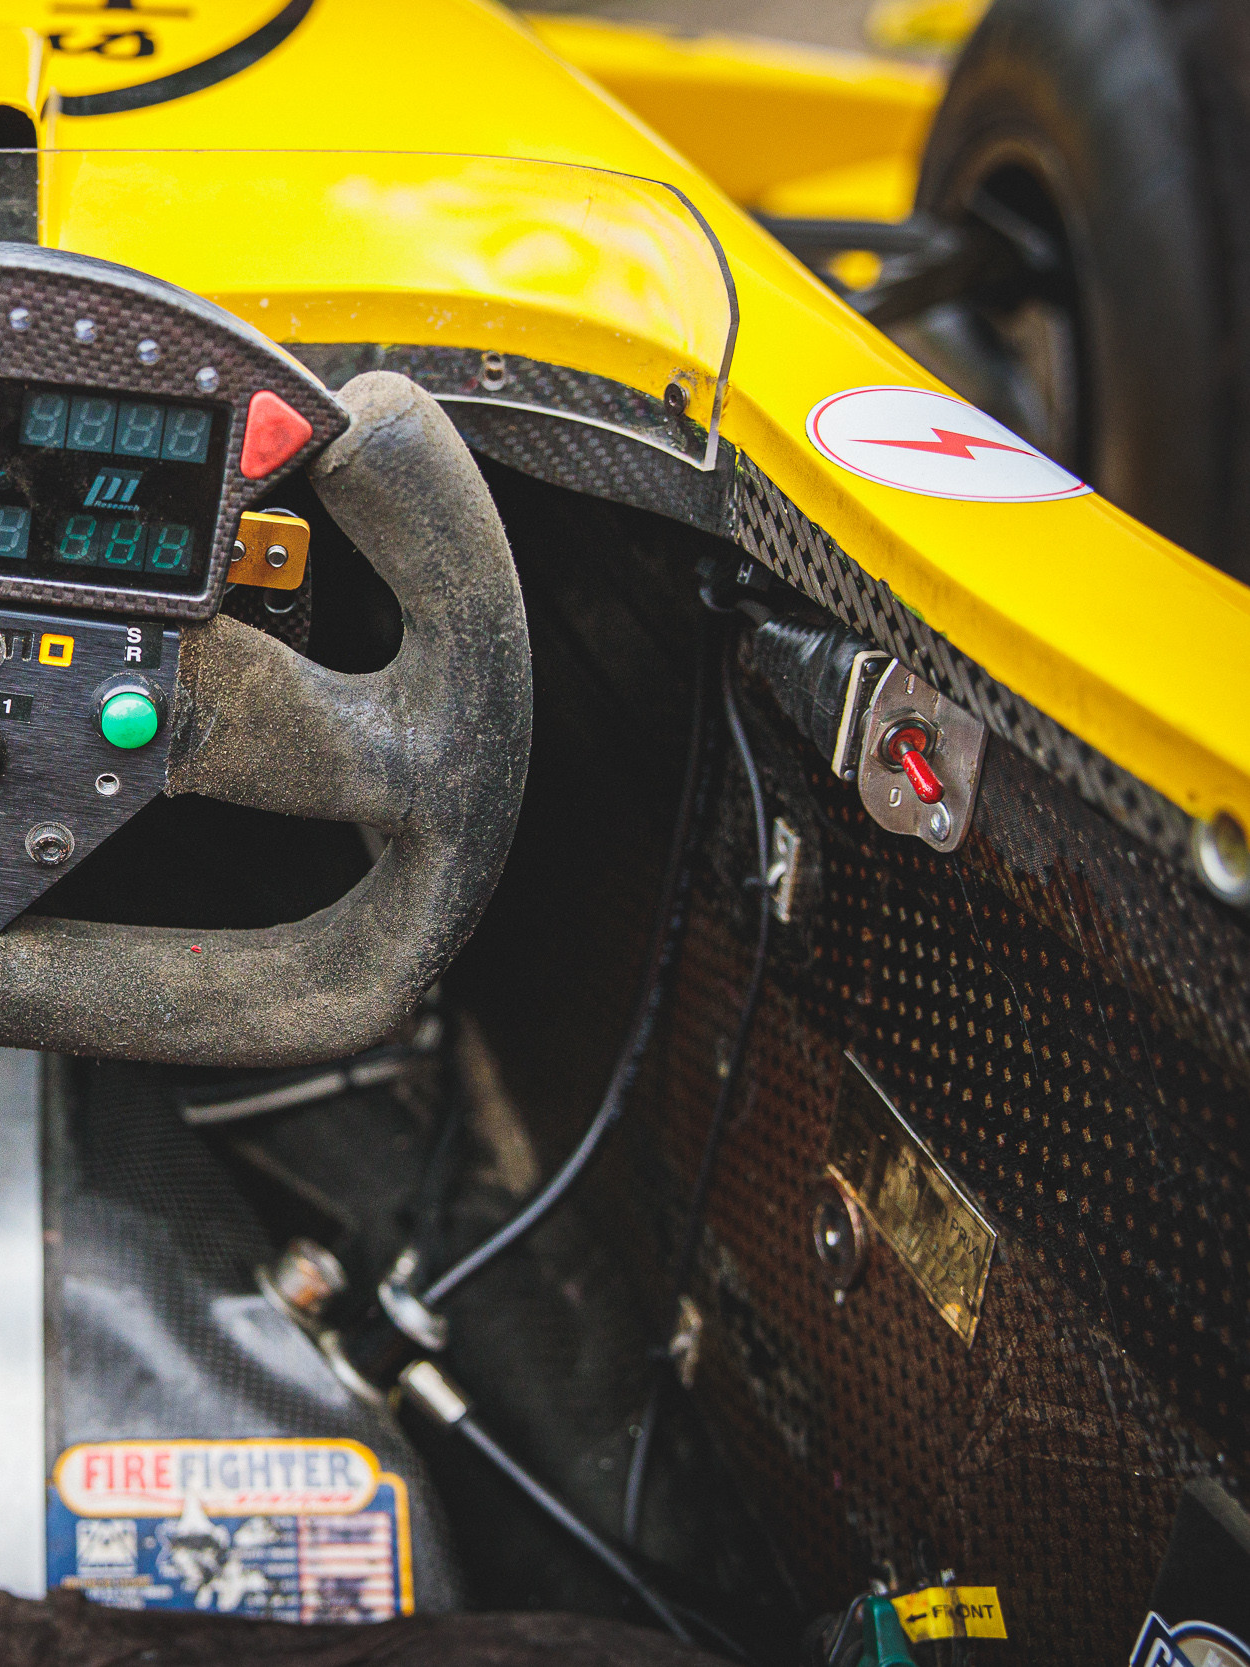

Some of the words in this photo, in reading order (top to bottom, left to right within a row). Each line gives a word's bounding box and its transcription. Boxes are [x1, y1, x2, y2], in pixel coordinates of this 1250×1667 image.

[126, 627, 142, 643] S
[125, 646, 142, 662] R
[2, 699, 12, 714] 1
[84, 1451, 354, 1490] FIREFIGHTER
